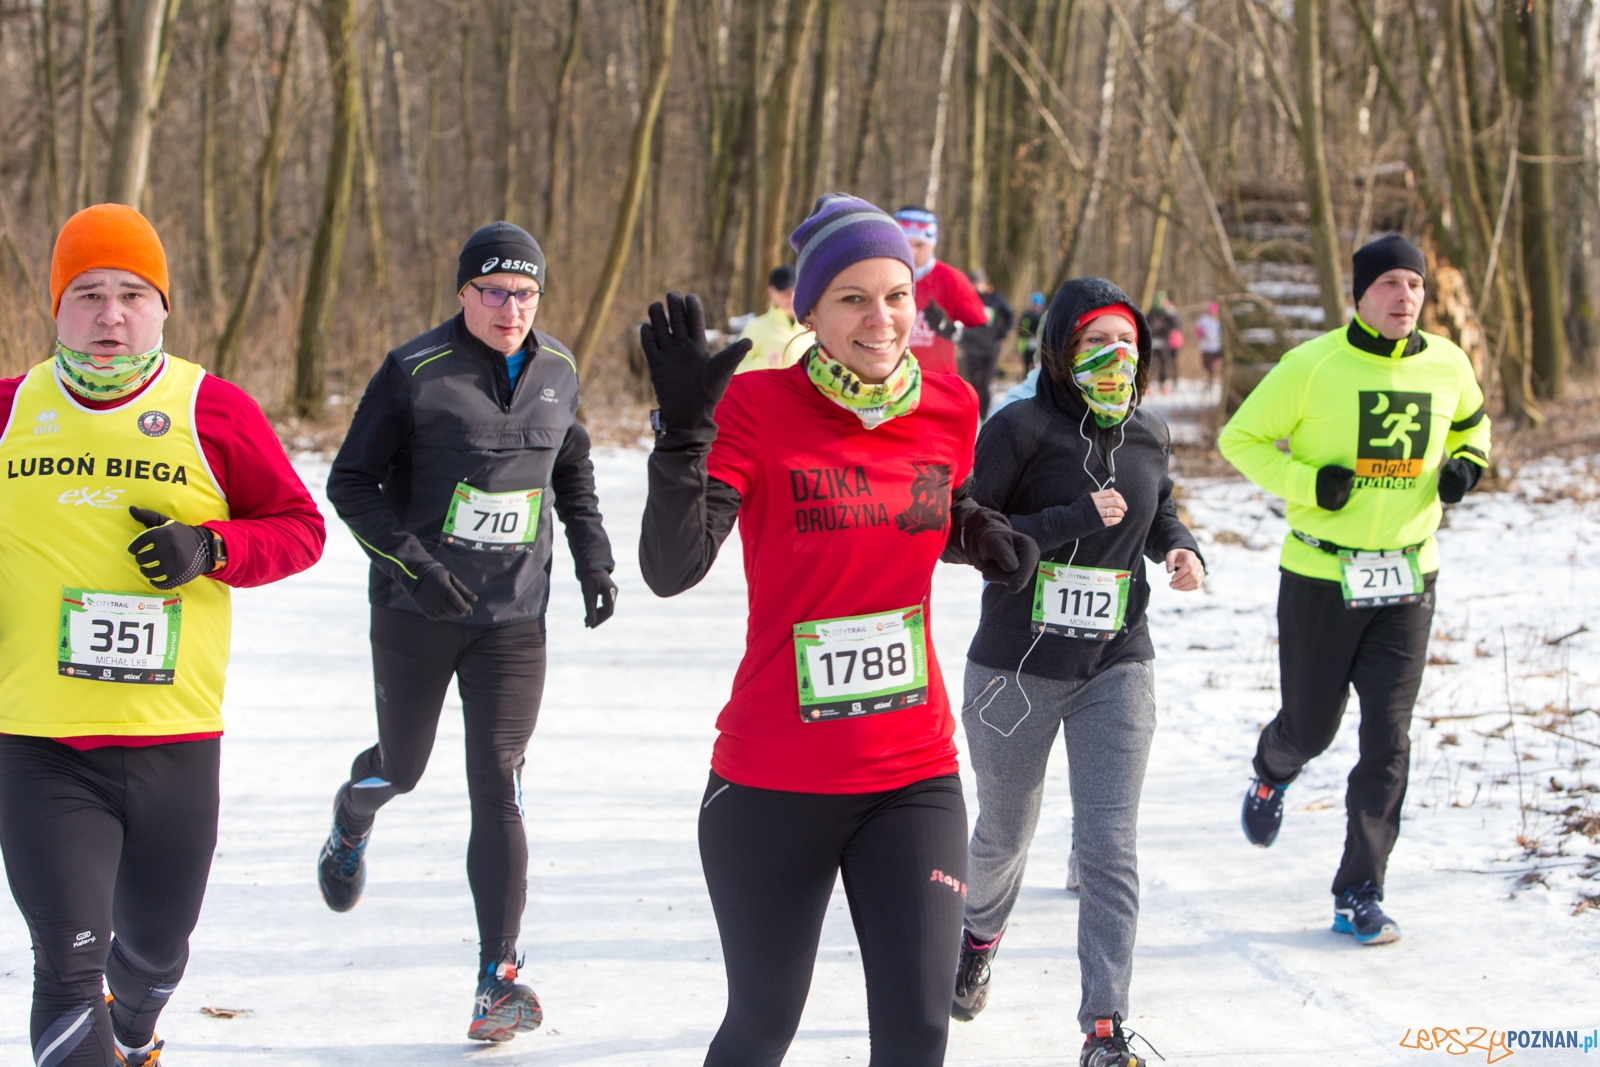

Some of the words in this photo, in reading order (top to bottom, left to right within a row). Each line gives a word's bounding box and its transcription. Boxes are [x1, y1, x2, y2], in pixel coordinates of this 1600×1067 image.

[501, 259, 539, 275] asics
[8, 453, 95, 479] LUBOŃ
[106, 458, 188, 486] BIEGA
[1371, 459, 1412, 475] night
[790, 465, 873, 502] DZIKA
[472, 509, 519, 534] 710
[795, 501, 891, 533] DRUŻYNA
[1360, 566, 1402, 588] 271
[1058, 587, 1111, 618] 1112
[90, 619, 155, 655] 351
[1069, 618, 1096, 628] MONIKA
[95, 656, 129, 667] MICHAŁ
[131, 658, 148, 668] LKB
[819, 642, 907, 686] 1788
